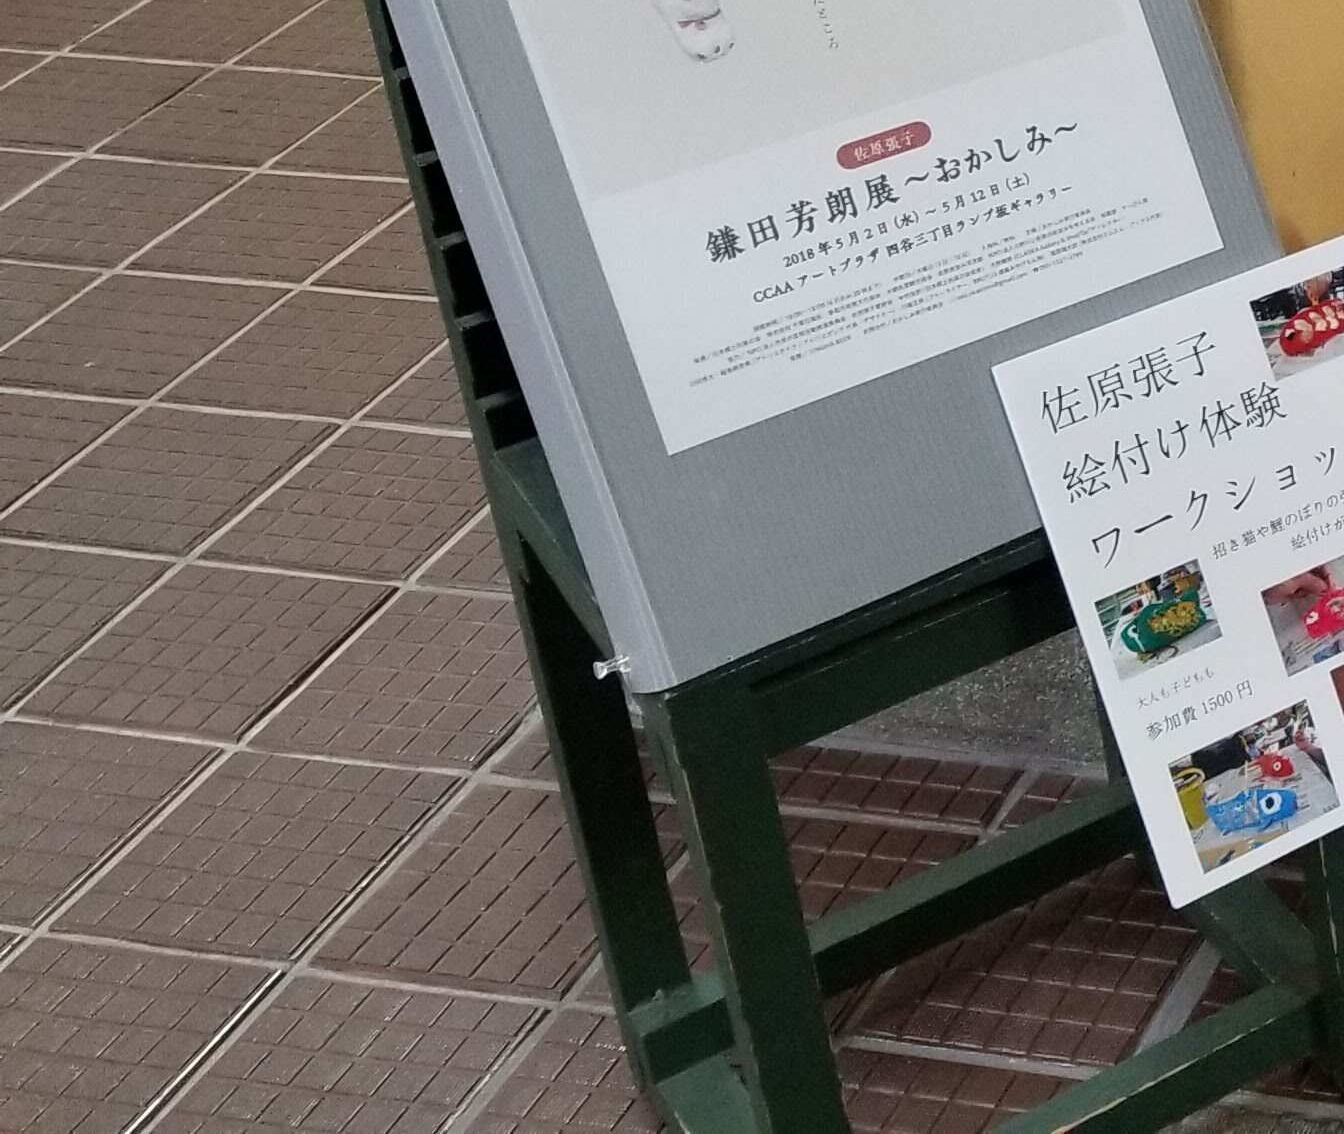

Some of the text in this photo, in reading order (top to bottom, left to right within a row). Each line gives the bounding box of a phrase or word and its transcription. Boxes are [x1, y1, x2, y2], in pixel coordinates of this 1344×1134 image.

[853, 127, 917, 162] 佐原張子
[752, 281, 795, 304] CCAA
[1040, 331, 1217, 434] 佐原張子
[1061, 381, 1288, 503] 絵付け体験
[1136, 665, 1215, 709] 大人も子どもも
